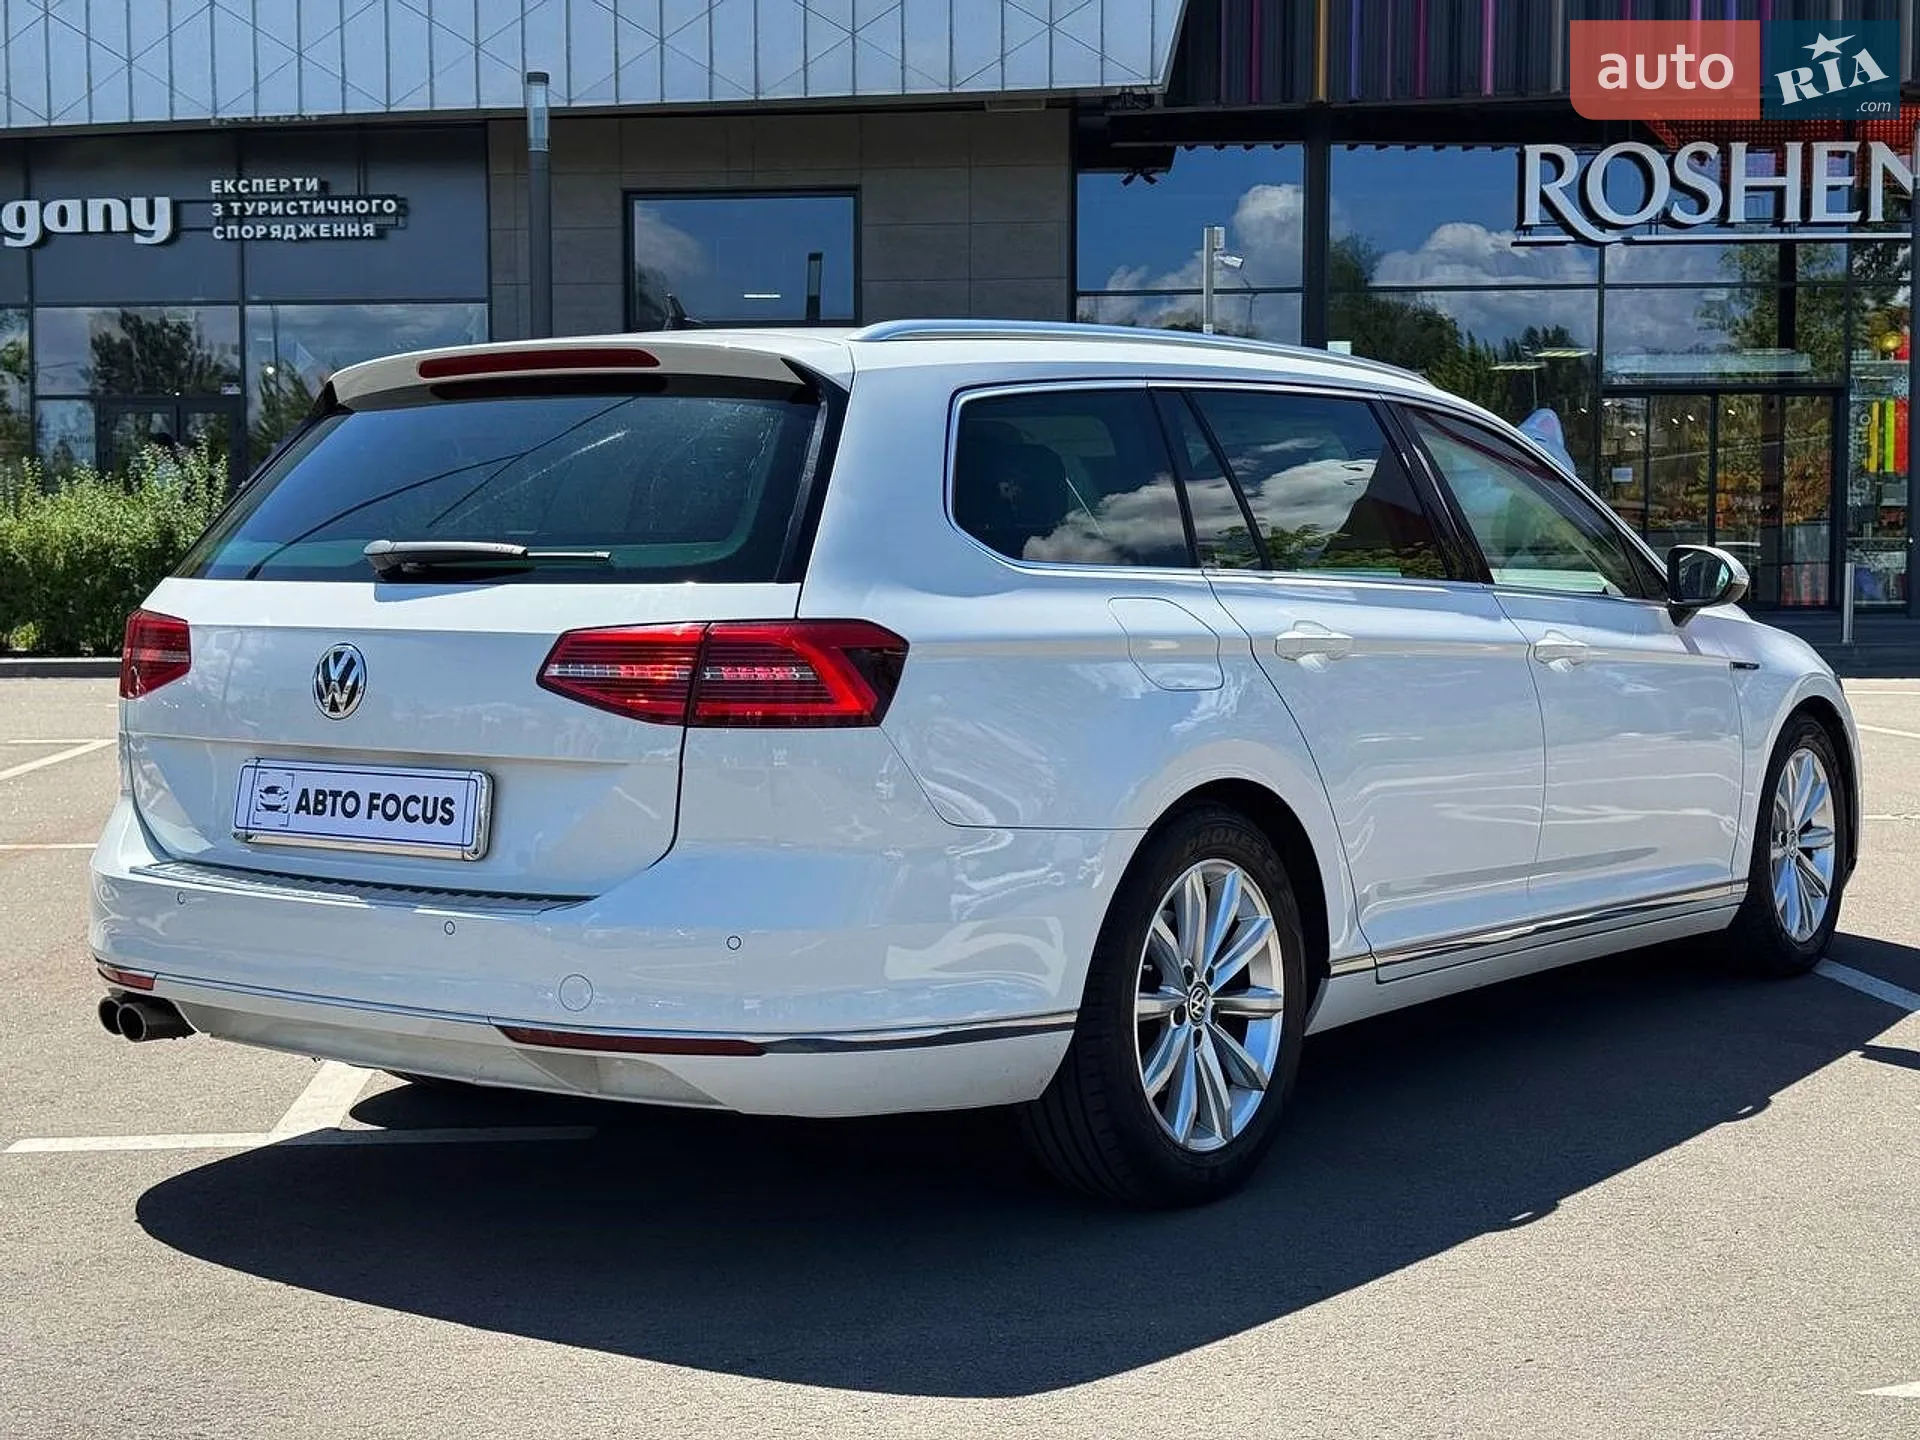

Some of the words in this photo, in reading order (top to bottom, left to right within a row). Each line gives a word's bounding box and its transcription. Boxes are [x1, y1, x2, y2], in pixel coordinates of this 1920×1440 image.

[210, 177, 319, 194] ЕКСПЕРТИ
[1522, 140, 1913, 242] ROSHEN
[230, 199, 397, 216] ТУРИСТИЧНОГО
[1, 196, 171, 248] gany
[212, 223, 376, 241] СПОРЯДЖЕННЯ
[366, 791, 456, 826] FOCUS
